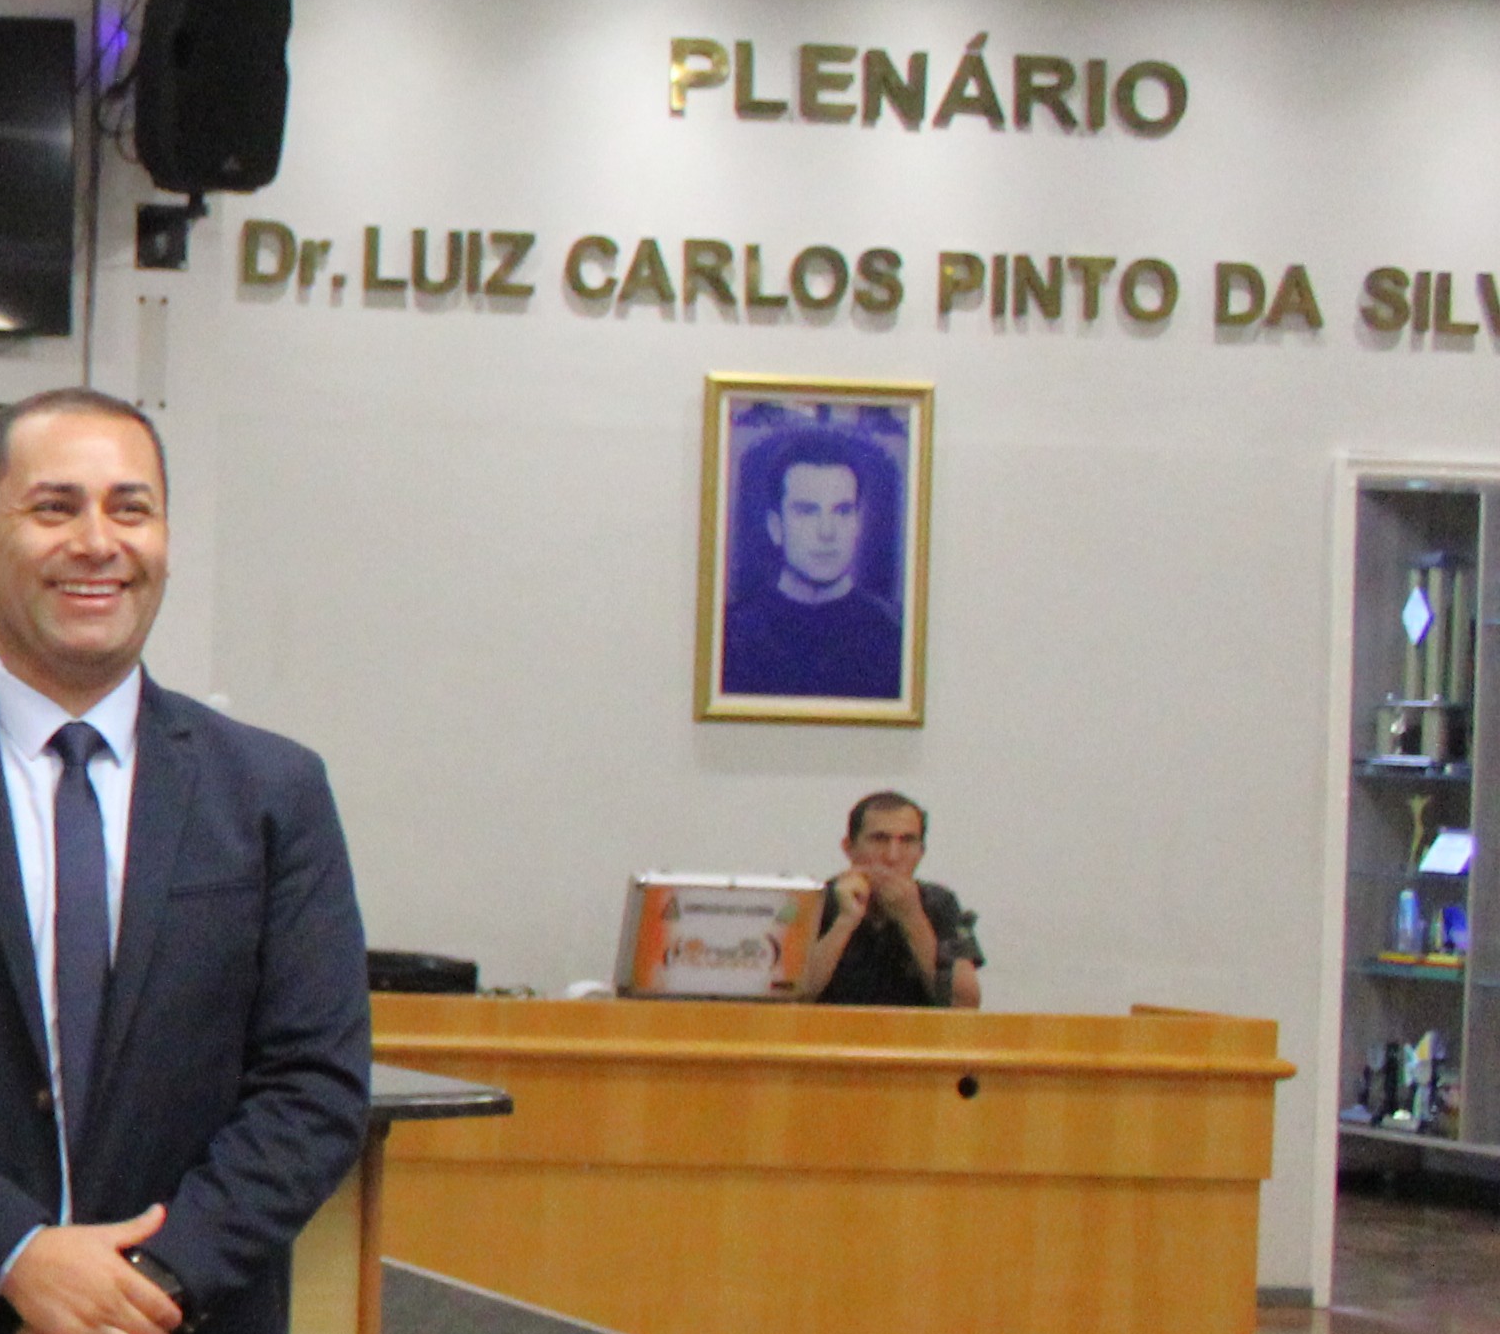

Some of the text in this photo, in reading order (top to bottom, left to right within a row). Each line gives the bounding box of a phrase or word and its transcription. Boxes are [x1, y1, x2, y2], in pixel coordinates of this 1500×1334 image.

[668, 30, 1190, 139] PLENÁRIO
[238, 218, 347, 291] Dr.
[362, 224, 536, 299] LUIZ
[564, 234, 905, 315] CARLOS
[936, 250, 1180, 323] PINTO
[1213, 260, 1324, 331] DA
